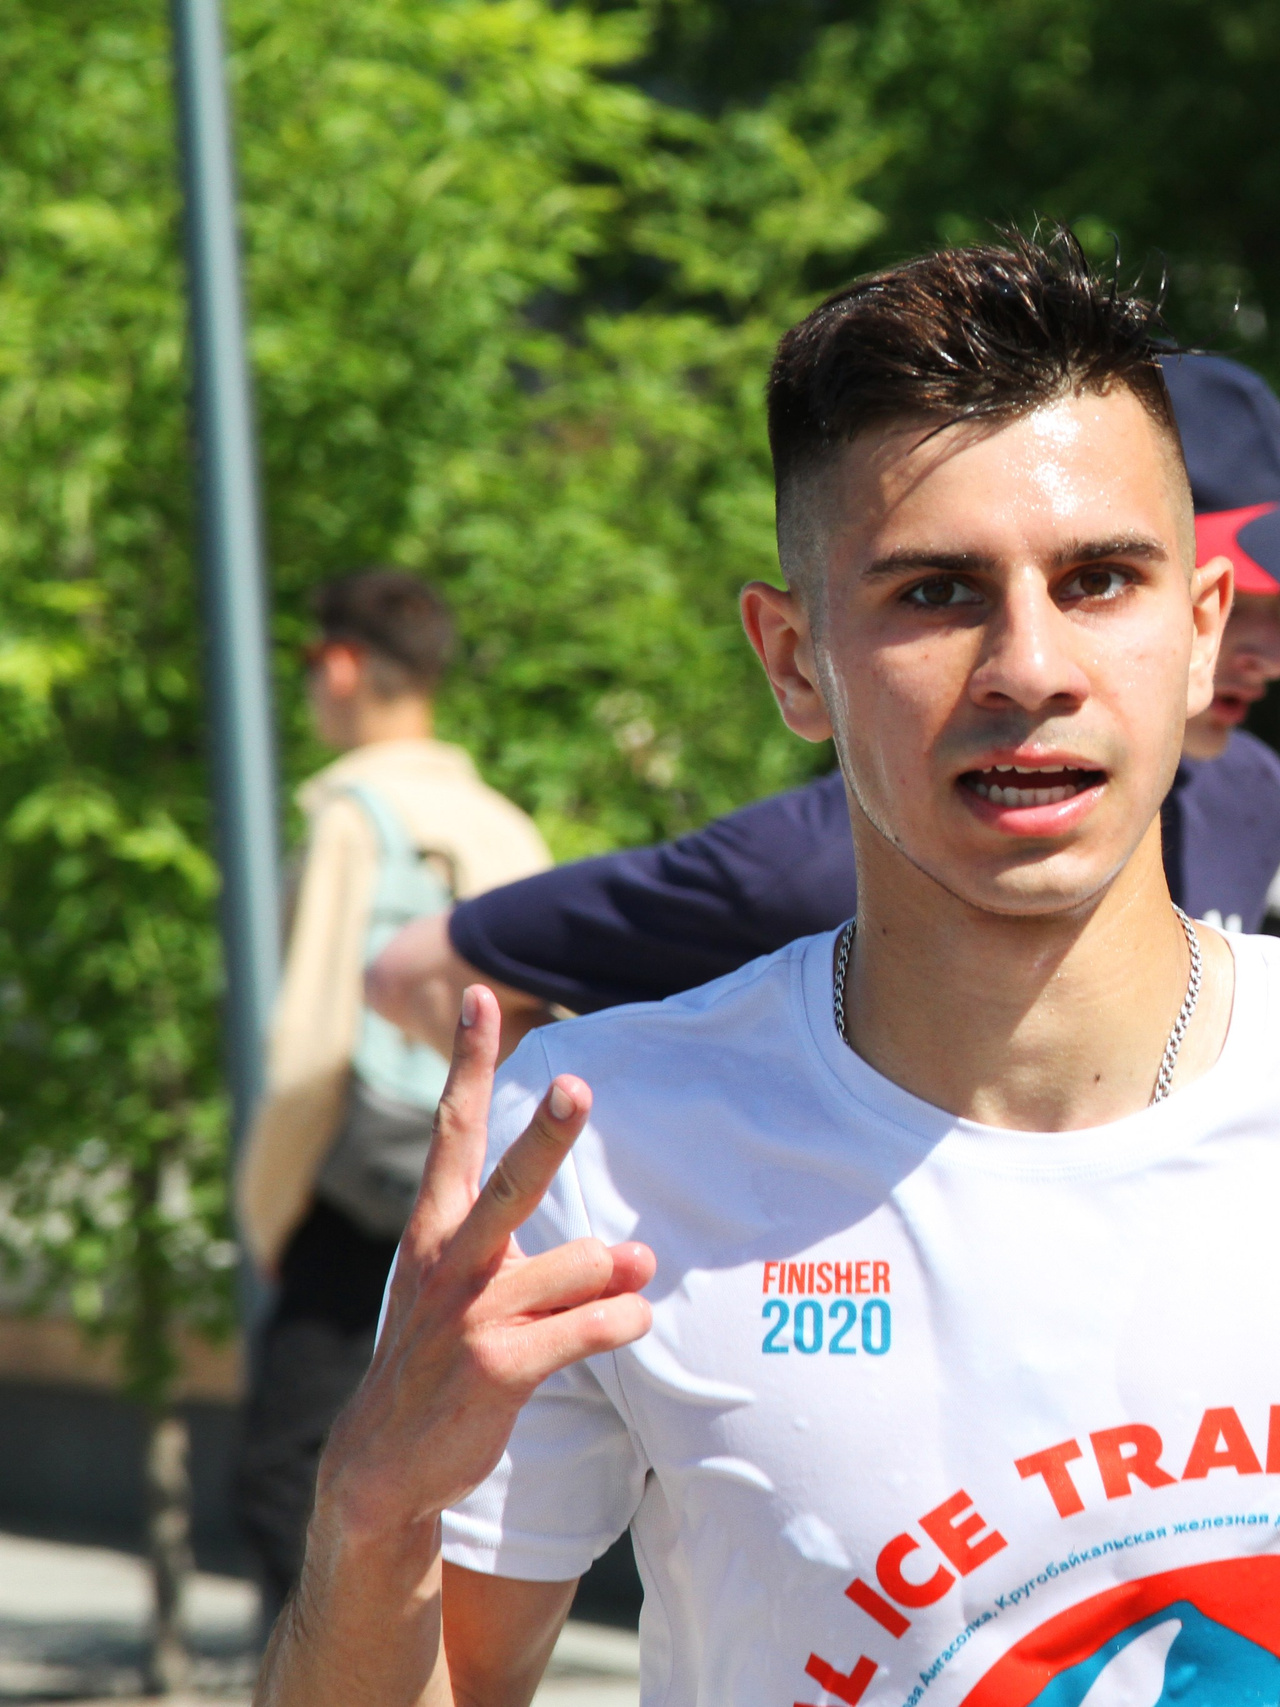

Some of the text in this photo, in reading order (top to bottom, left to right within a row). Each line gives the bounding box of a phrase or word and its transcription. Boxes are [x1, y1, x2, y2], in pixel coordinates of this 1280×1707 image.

[761, 1296, 893, 1357] 2020
[762, 1260, 891, 1295] FINISHER
[793, 1652, 879, 1707] L
[845, 1488, 1009, 1639] ICE
[919, 1611, 998, 1687] Ангасолка,
[994, 1525, 1167, 1610] Кругобайкальская
[1173, 1512, 1269, 1535] железная
